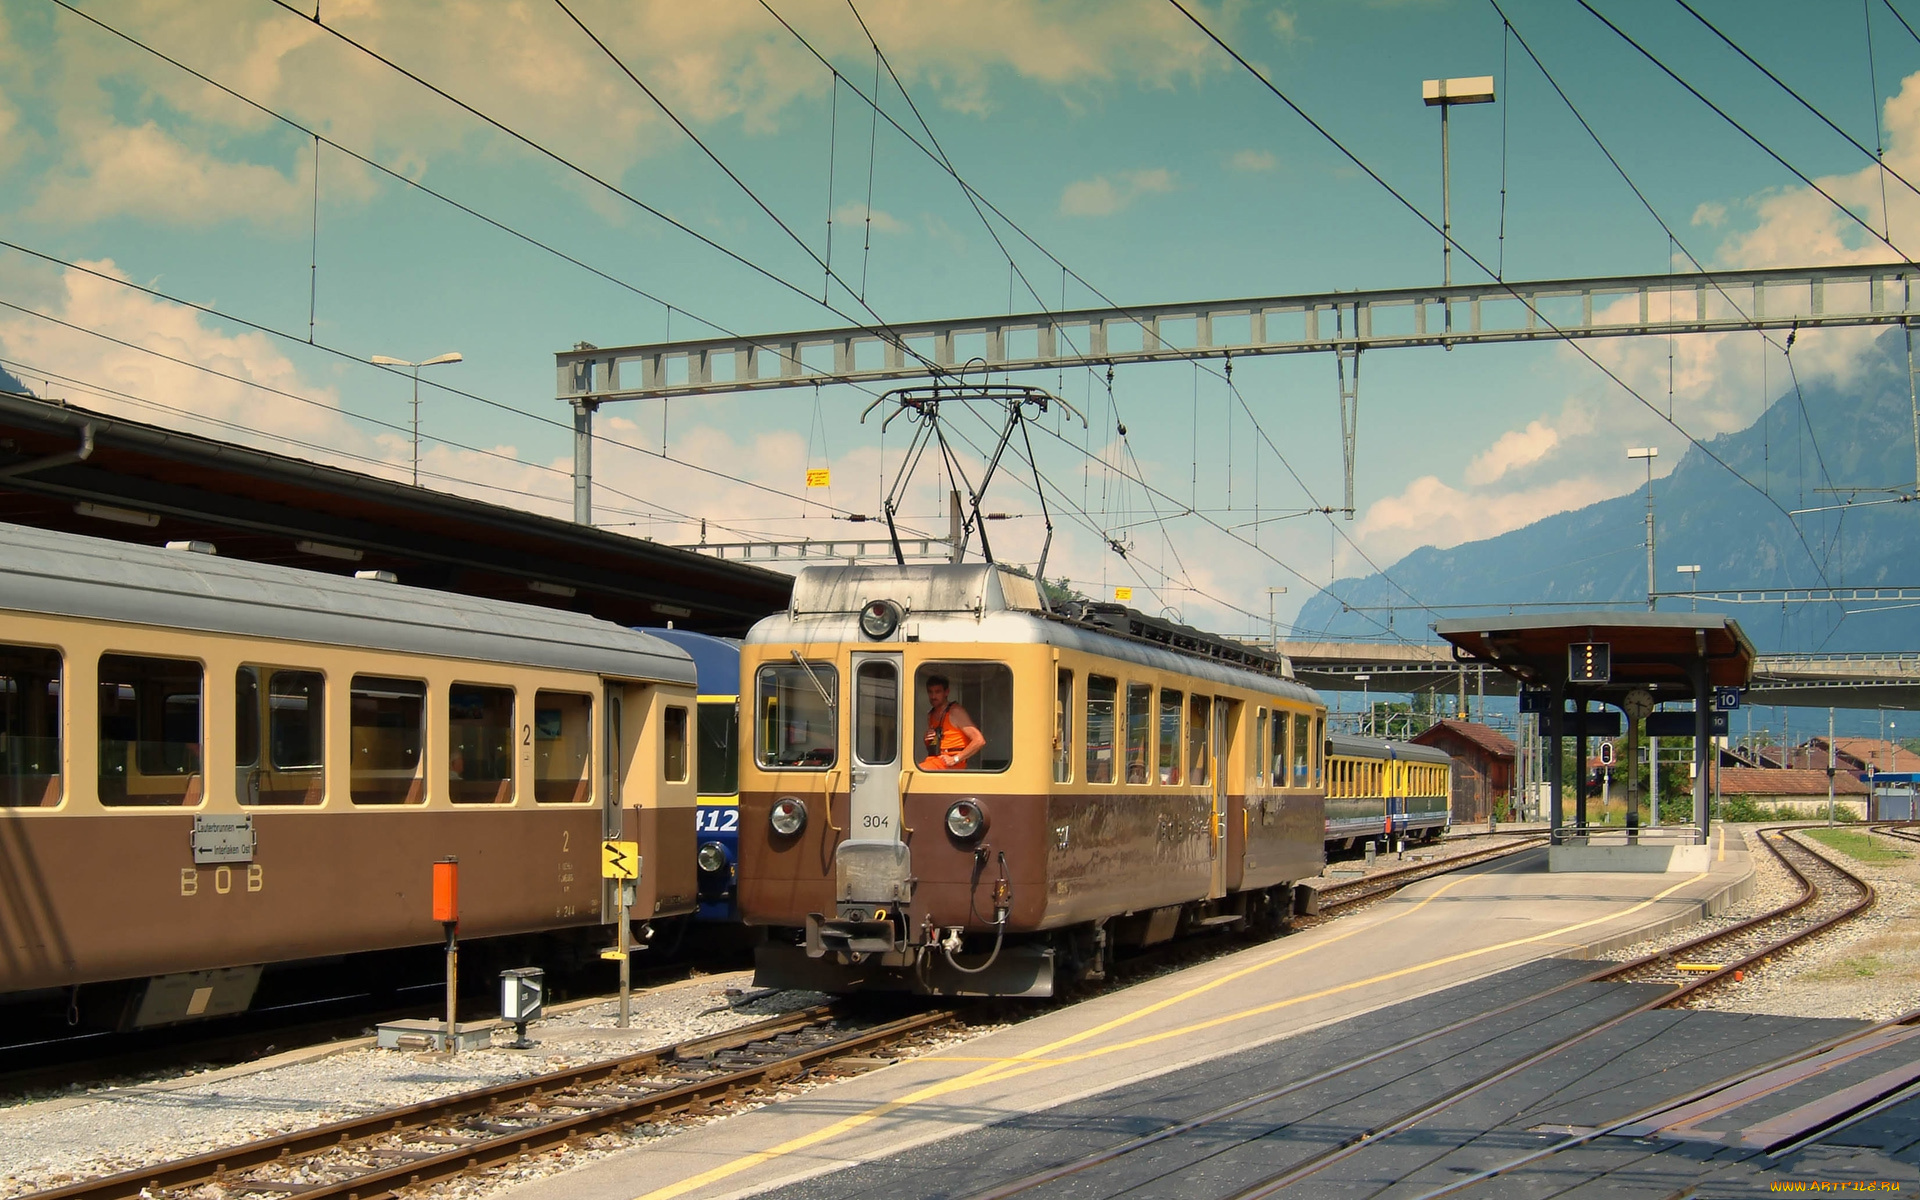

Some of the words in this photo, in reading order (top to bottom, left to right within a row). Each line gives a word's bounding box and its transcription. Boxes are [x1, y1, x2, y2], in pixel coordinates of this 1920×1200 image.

[1721, 694, 1736, 706] 10
[1714, 718, 1723, 726] 10
[523, 724, 531, 745] 2
[197, 823, 235, 832] Lauterbrunnen
[863, 815, 888, 828] 304
[563, 831, 569, 852] 2
[214, 845, 239, 854] Interlaken
[241, 844, 251, 854] Ost
